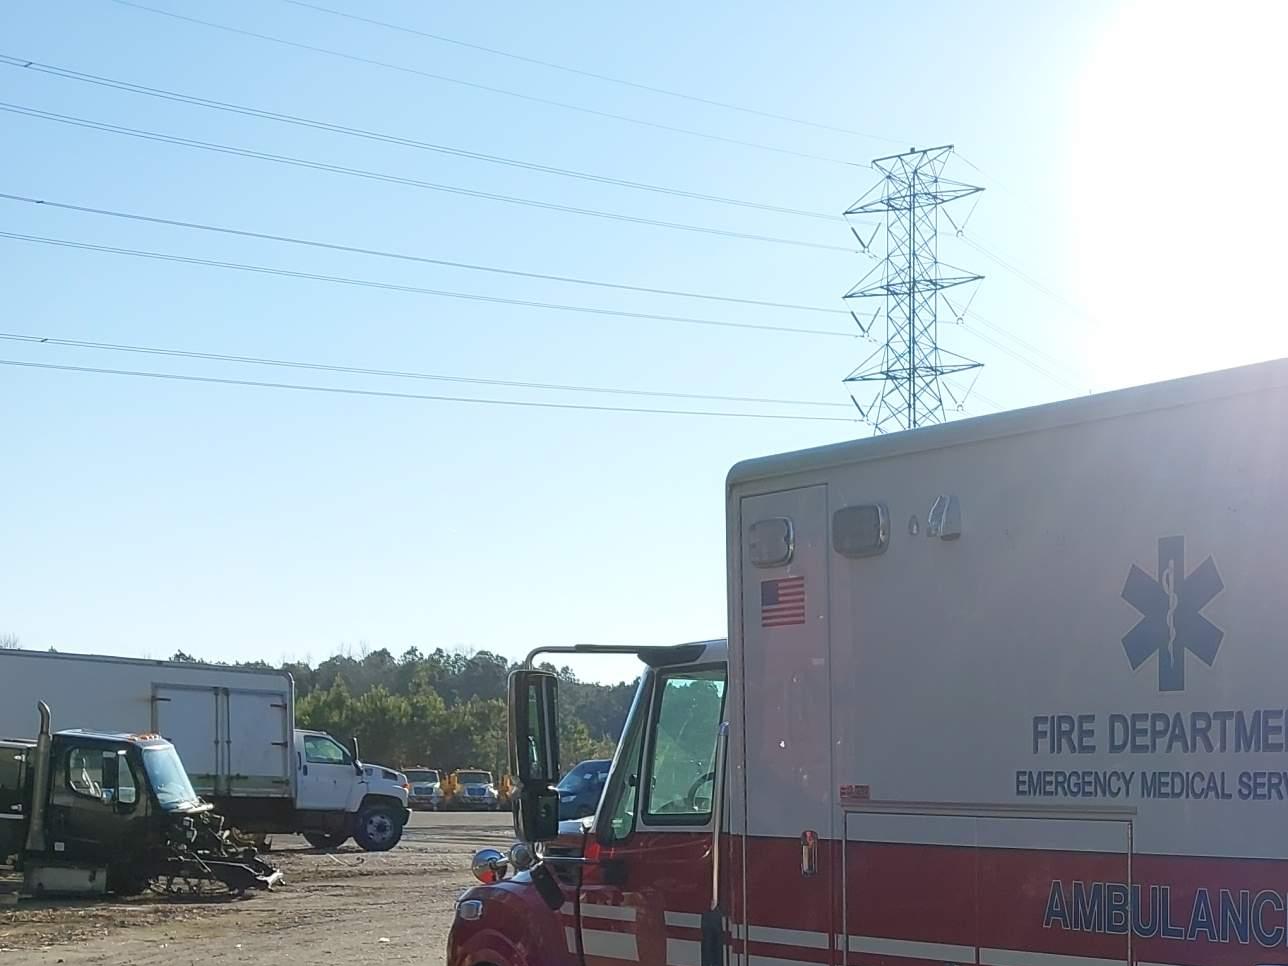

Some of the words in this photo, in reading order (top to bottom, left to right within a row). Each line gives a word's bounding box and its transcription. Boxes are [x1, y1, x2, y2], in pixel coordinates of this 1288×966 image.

[1032, 714, 1096, 754] FIRE
[1015, 770, 1135, 798] EMERGENCY
[1141, 771, 1232, 799] MEDICAL
